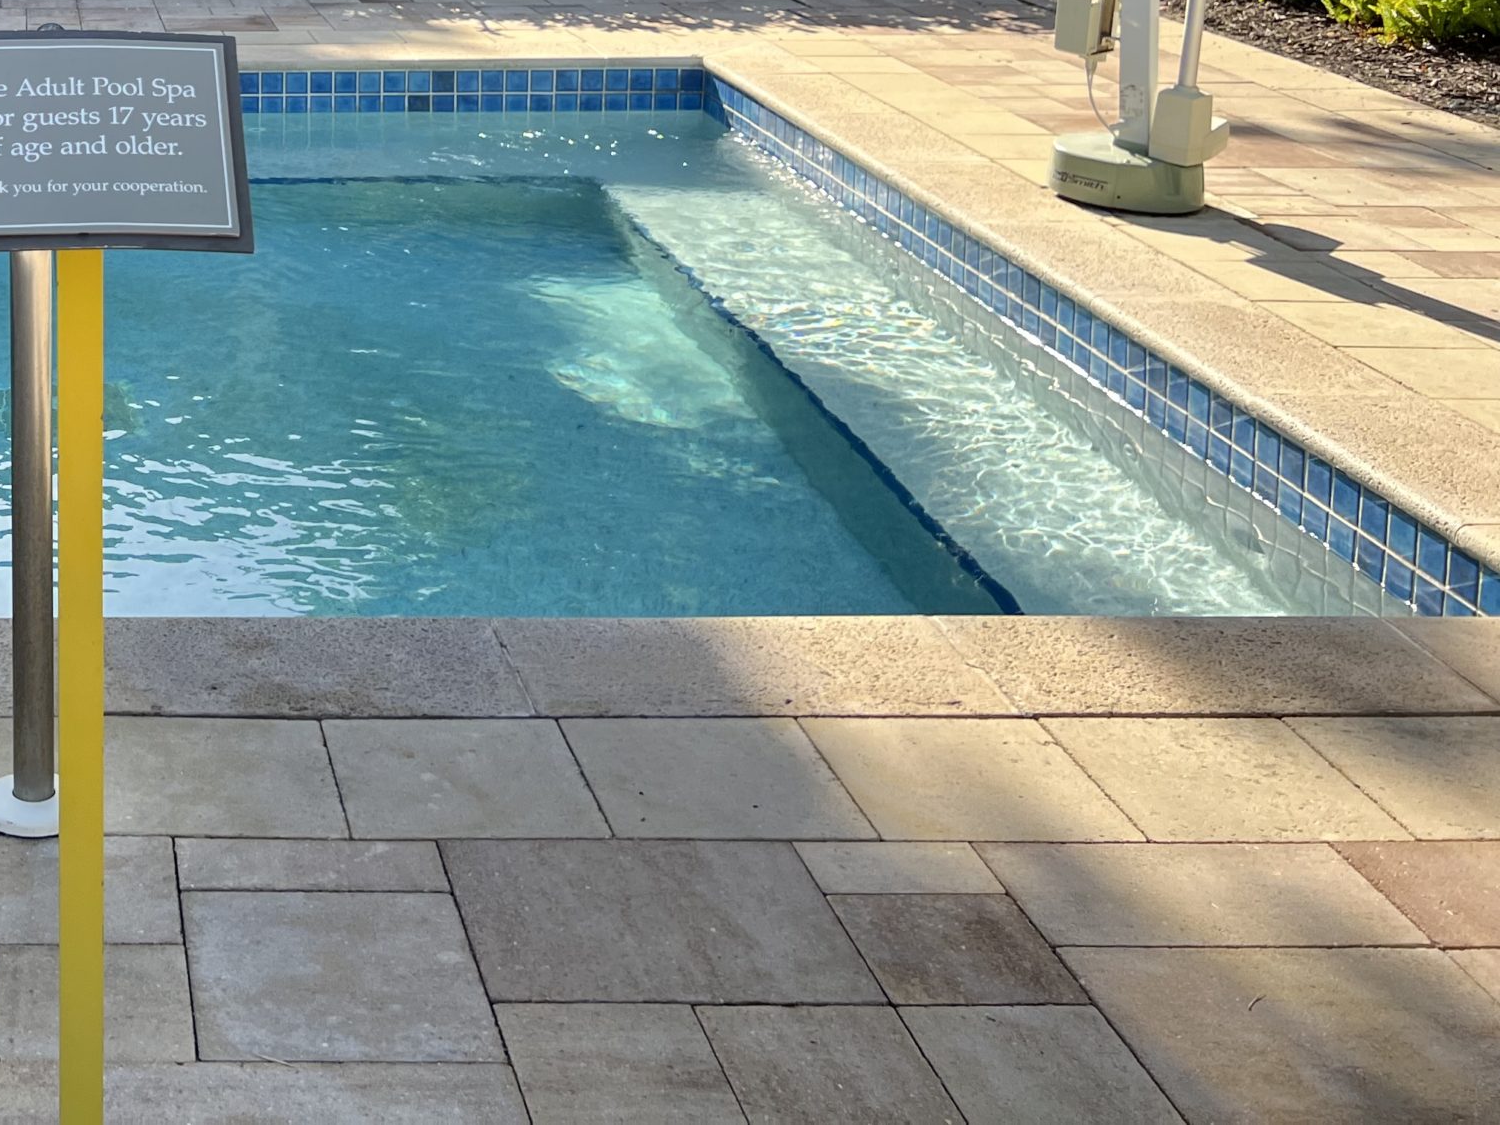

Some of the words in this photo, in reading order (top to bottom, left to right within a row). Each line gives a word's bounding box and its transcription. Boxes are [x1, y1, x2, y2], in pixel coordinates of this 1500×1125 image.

[16, 77, 84, 97] Adult
[92, 77, 143, 96] Pool
[152, 78, 196, 103] Spa
[23, 109, 100, 132] guests
[109, 107, 134, 124] 17
[141, 111, 206, 131] years
[11, 140, 52, 162] age
[60, 136, 106, 155] and
[115, 136, 182, 156] older.
[13, 182, 42, 196] you
[47, 180, 68, 192] for
[72, 181, 109, 196] your
[113, 180, 207, 195] cooperation.
